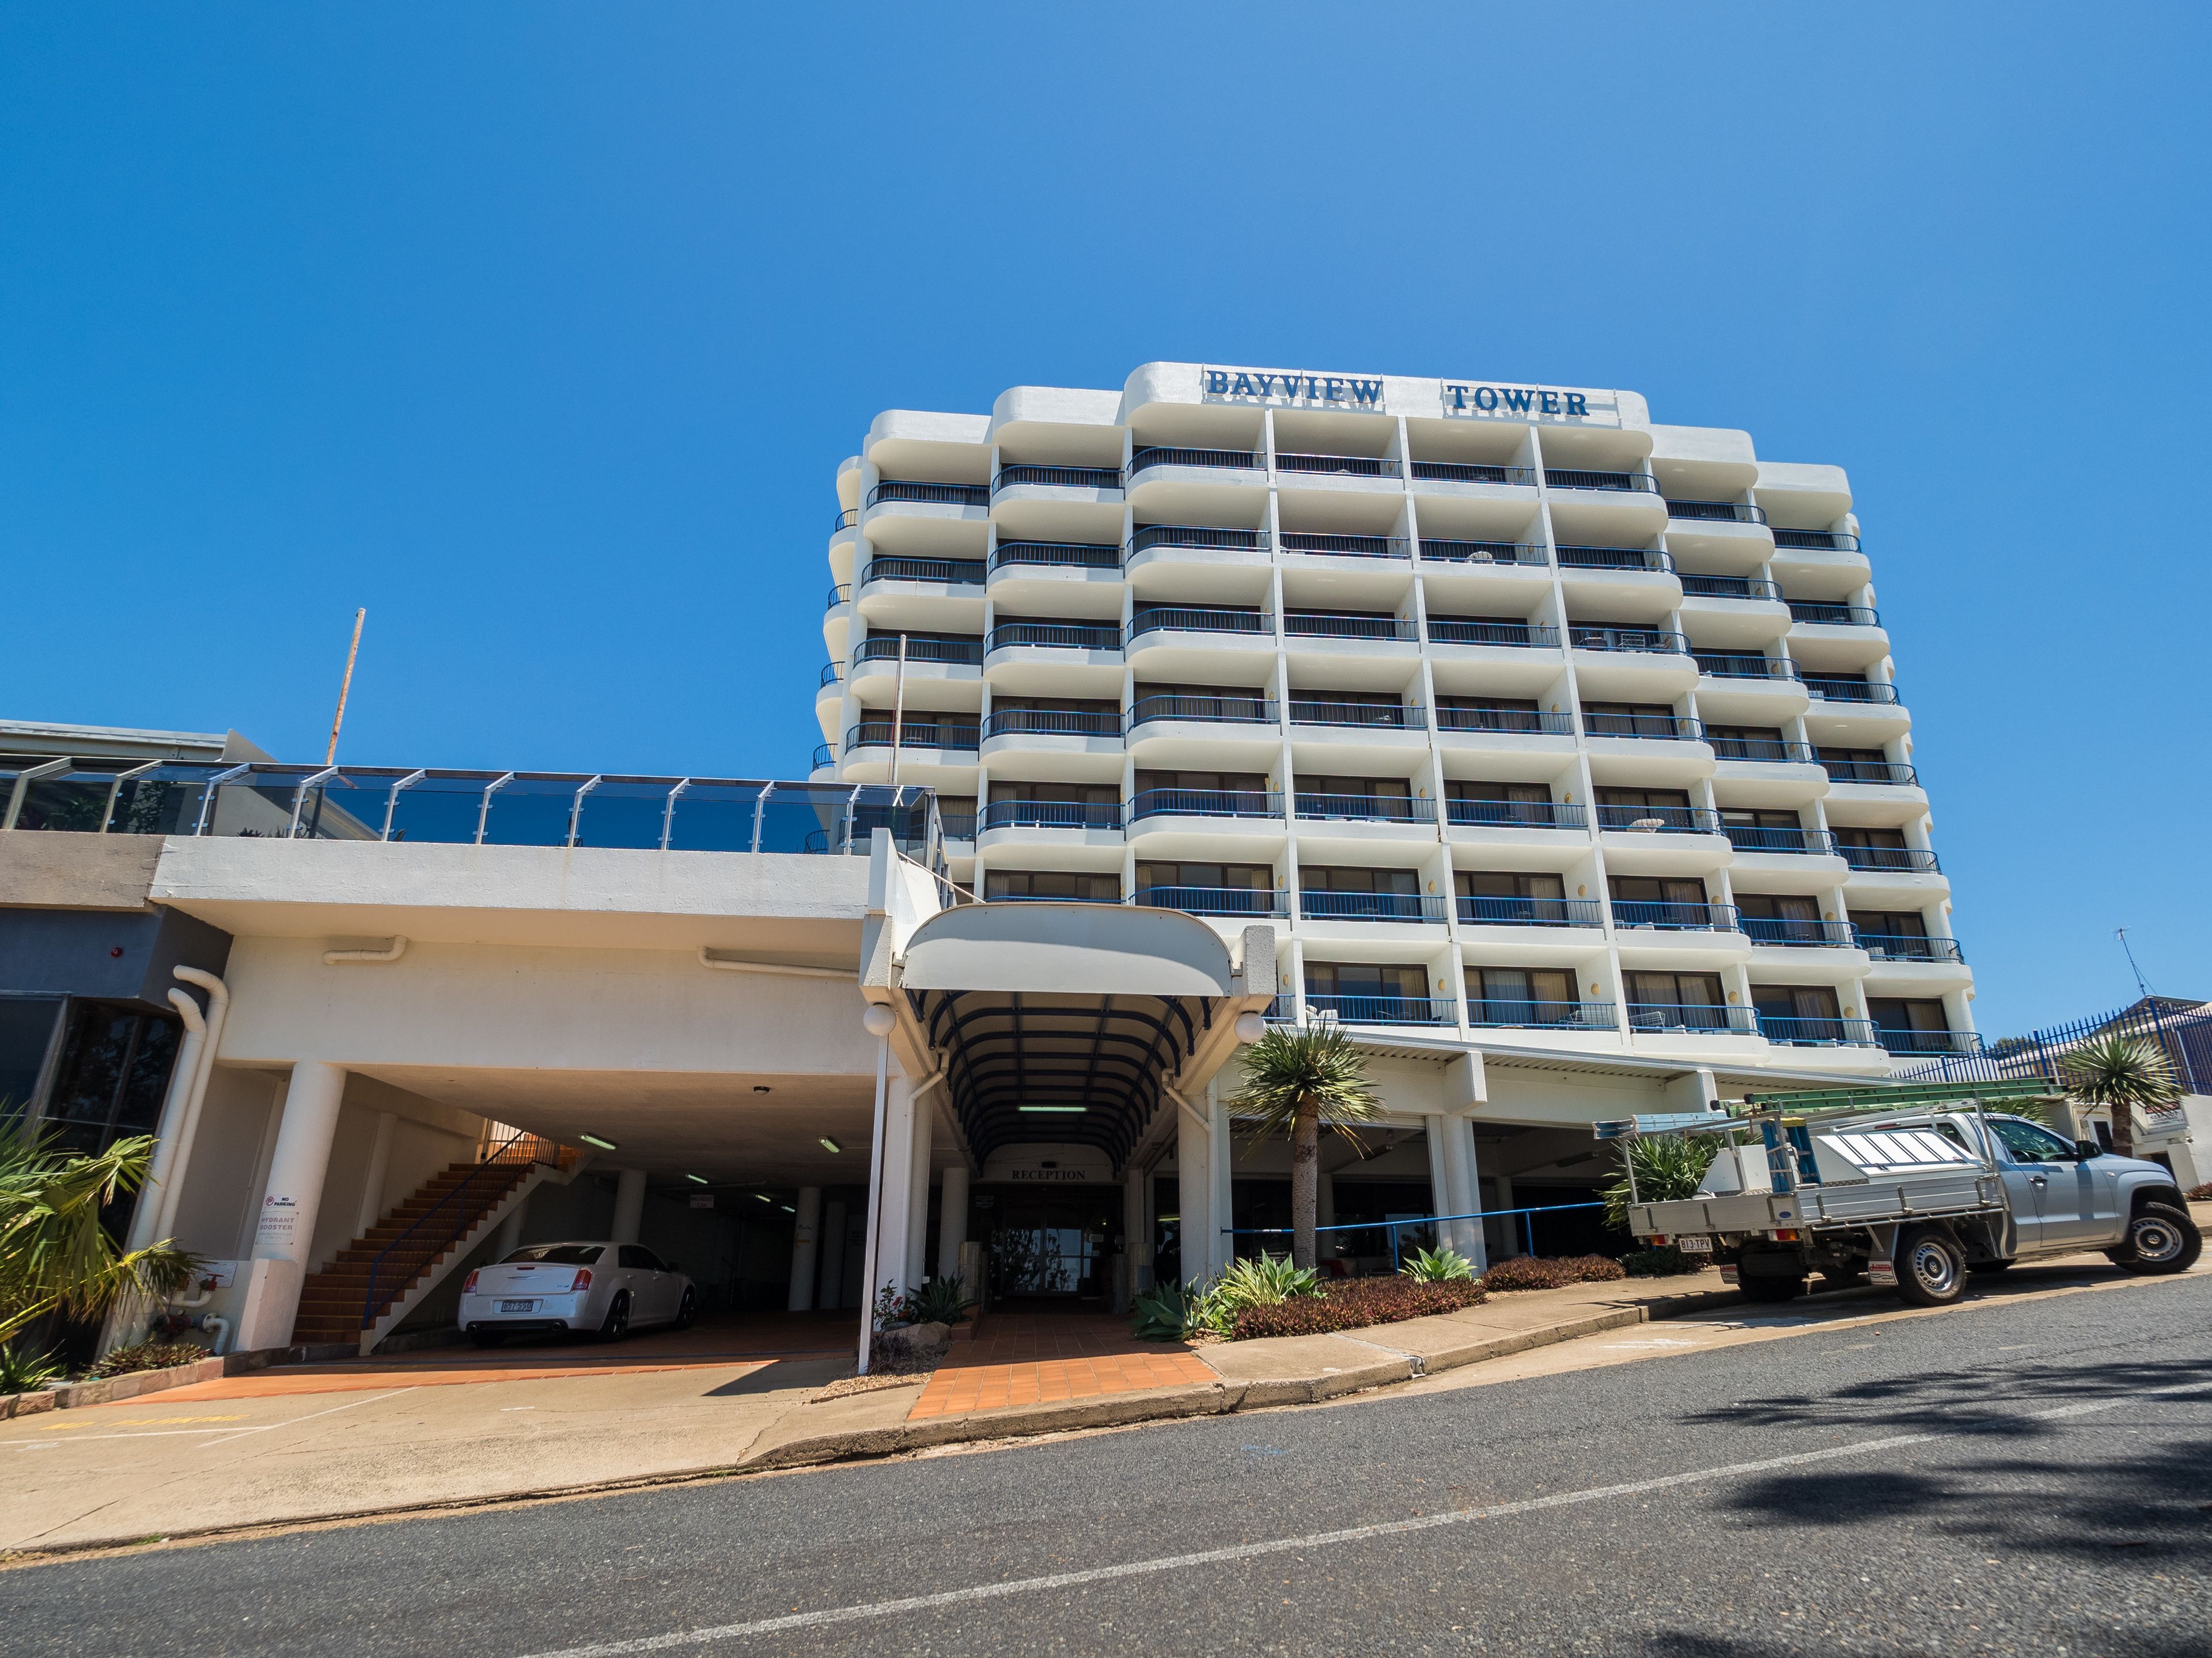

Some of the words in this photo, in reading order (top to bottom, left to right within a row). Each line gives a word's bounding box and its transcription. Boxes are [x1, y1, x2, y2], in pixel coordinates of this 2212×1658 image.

[1207, 370, 1383, 403] BAYVIEW
[1447, 385, 1590, 416] TOWER
[1012, 1170, 1085, 1180] RECEPTION
